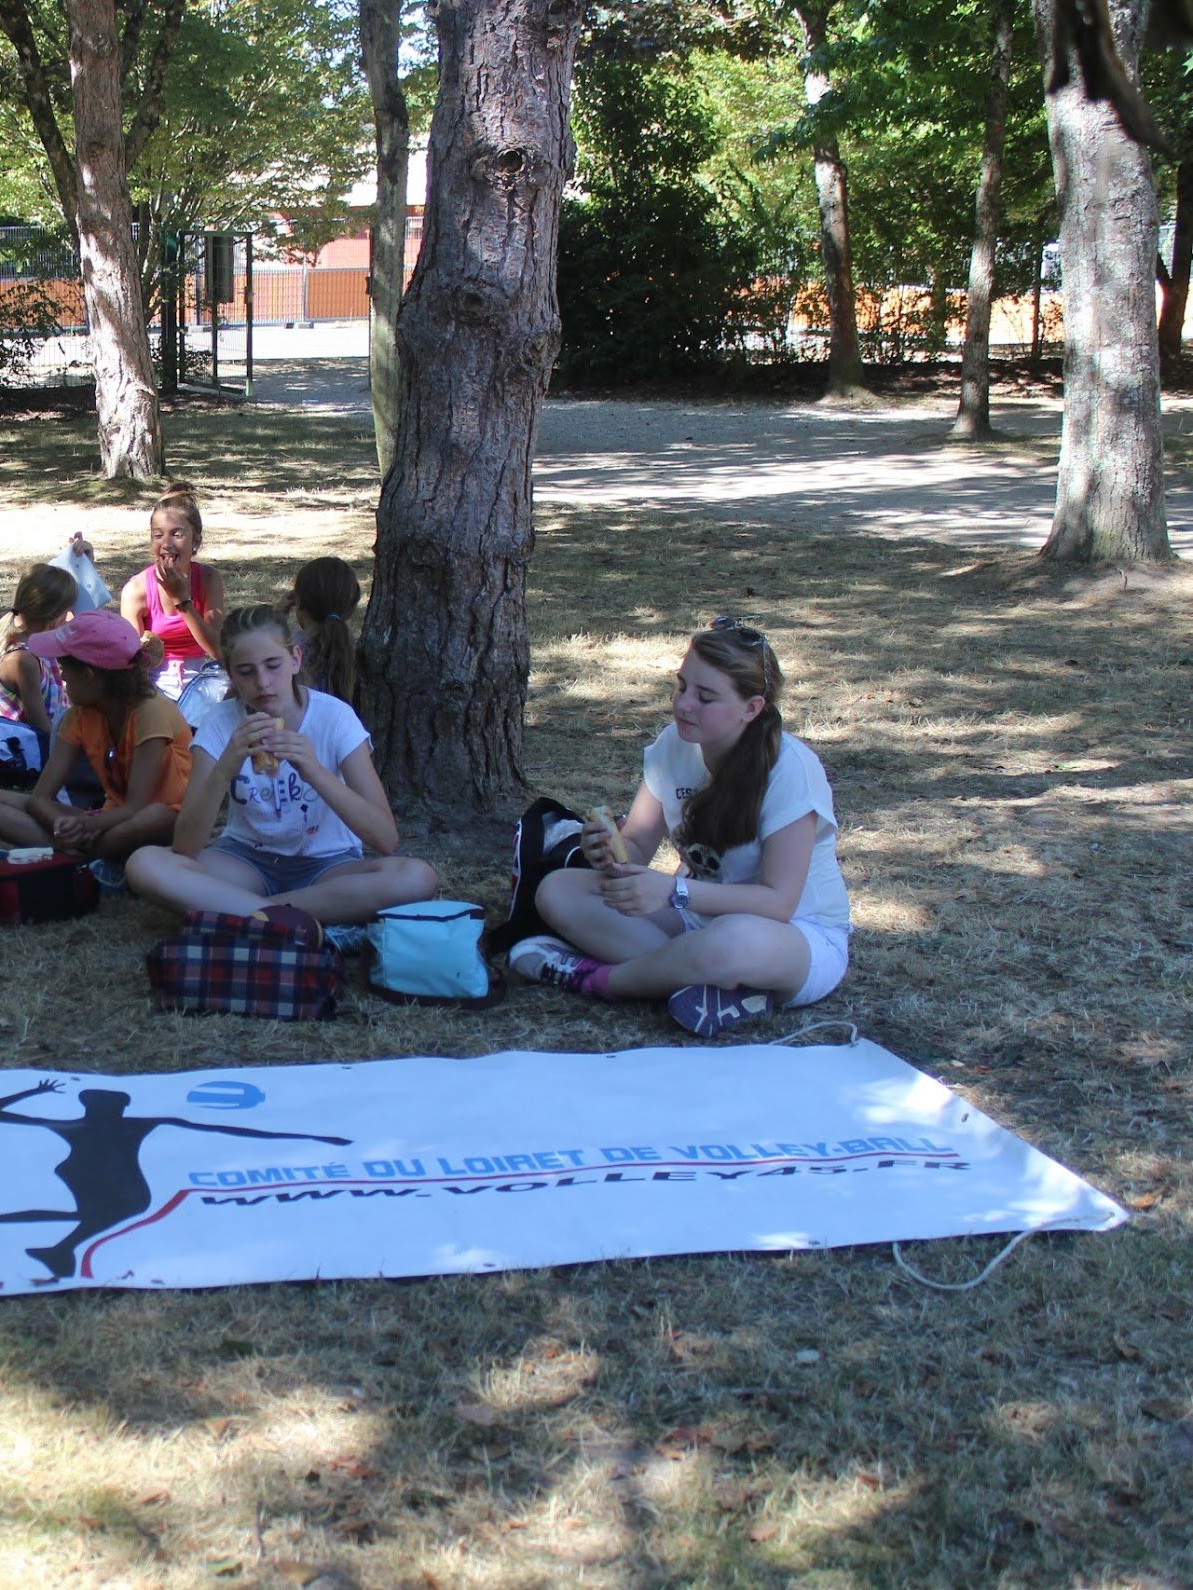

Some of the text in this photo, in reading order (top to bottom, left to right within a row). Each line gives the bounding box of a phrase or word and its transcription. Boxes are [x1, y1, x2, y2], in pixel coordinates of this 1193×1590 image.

[188, 1137, 955, 1187] COMITÉ DU LOIRET DE VOLLEY-BALL
